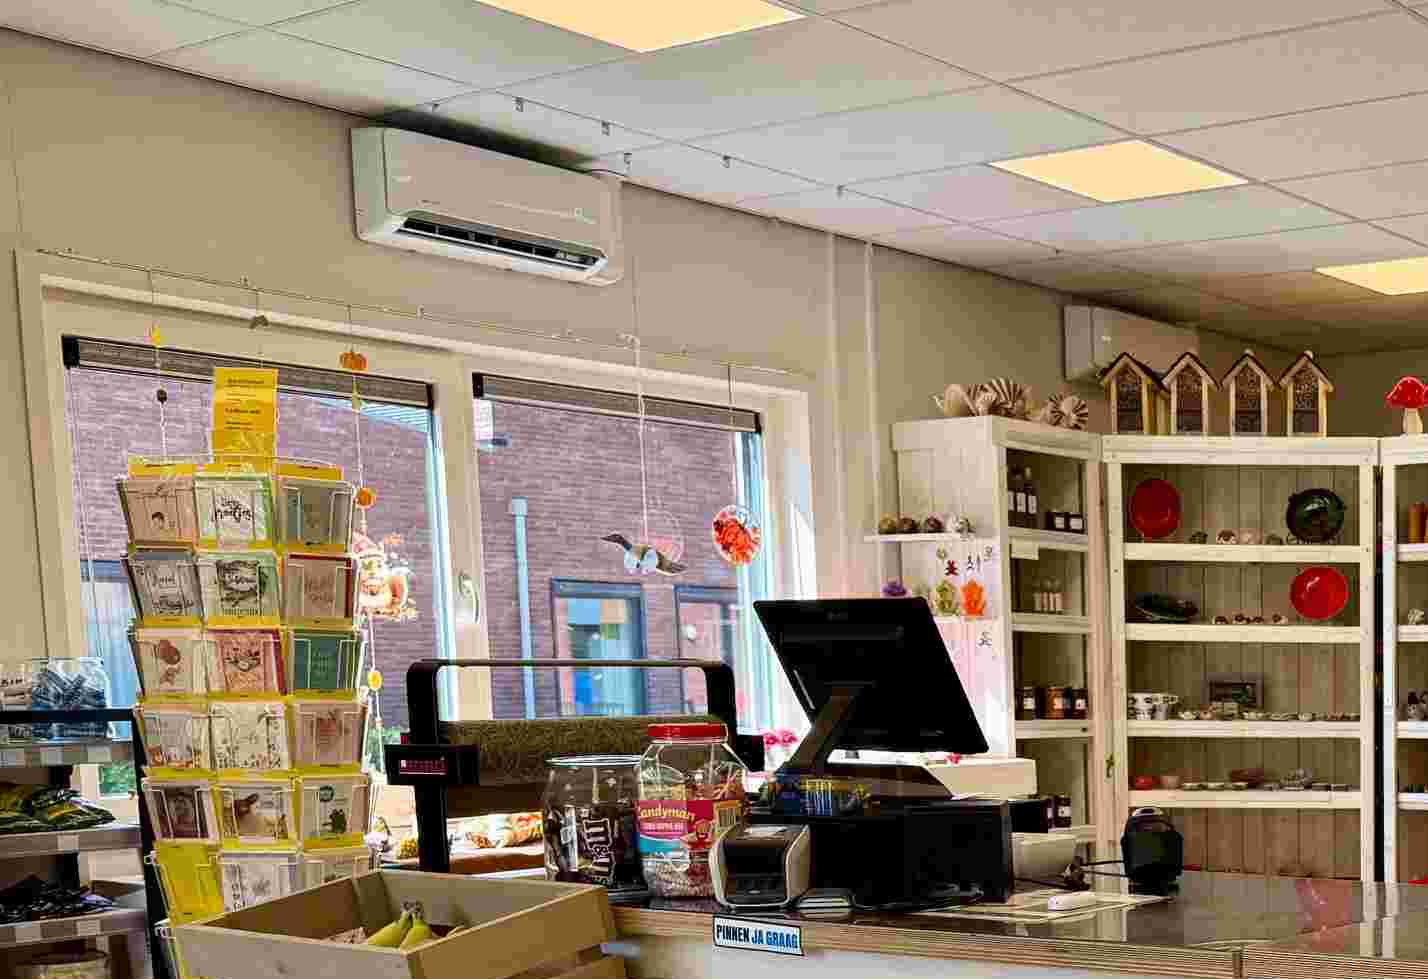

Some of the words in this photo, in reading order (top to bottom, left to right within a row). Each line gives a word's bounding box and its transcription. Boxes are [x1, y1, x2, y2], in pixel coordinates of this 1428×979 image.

[716, 925, 750, 942] PINNEN
[751, 929, 764, 944] JA
[766, 931, 798, 948] GRAAG
